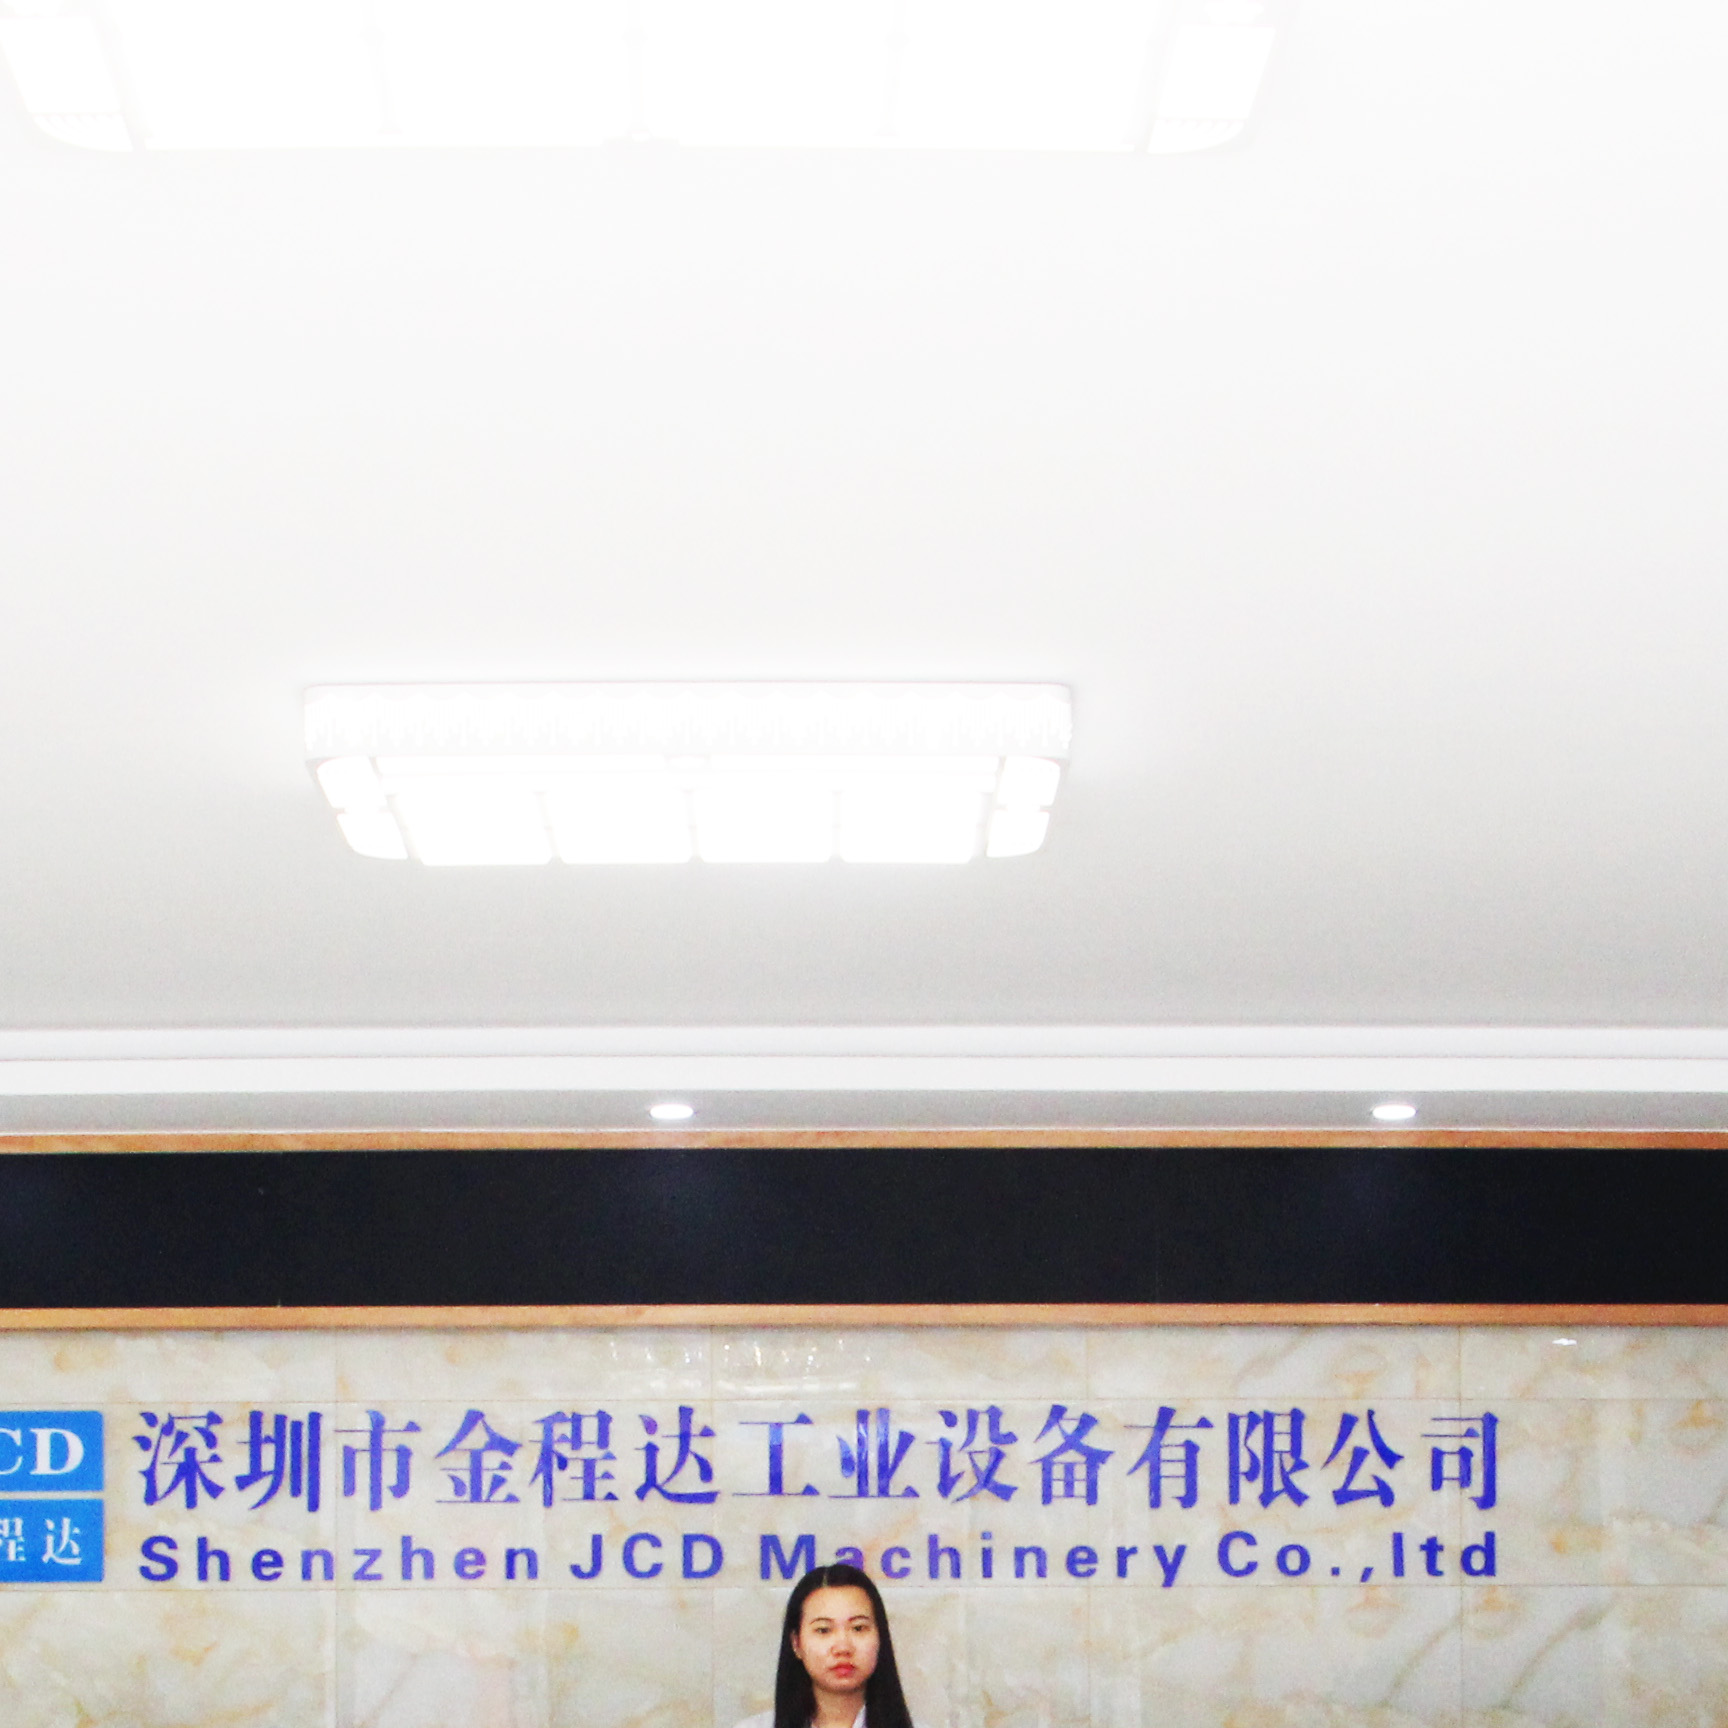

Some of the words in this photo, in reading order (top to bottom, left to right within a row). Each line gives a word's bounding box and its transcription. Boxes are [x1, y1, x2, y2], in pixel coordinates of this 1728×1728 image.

[134, 1404, 1499, 1513] 深圳市金程达工业设备有限公司
[139, 1534, 539, 1582] Shenzhen
[570, 1532, 725, 1580] JCD
[760, 1530, 1187, 1588] Machinery
